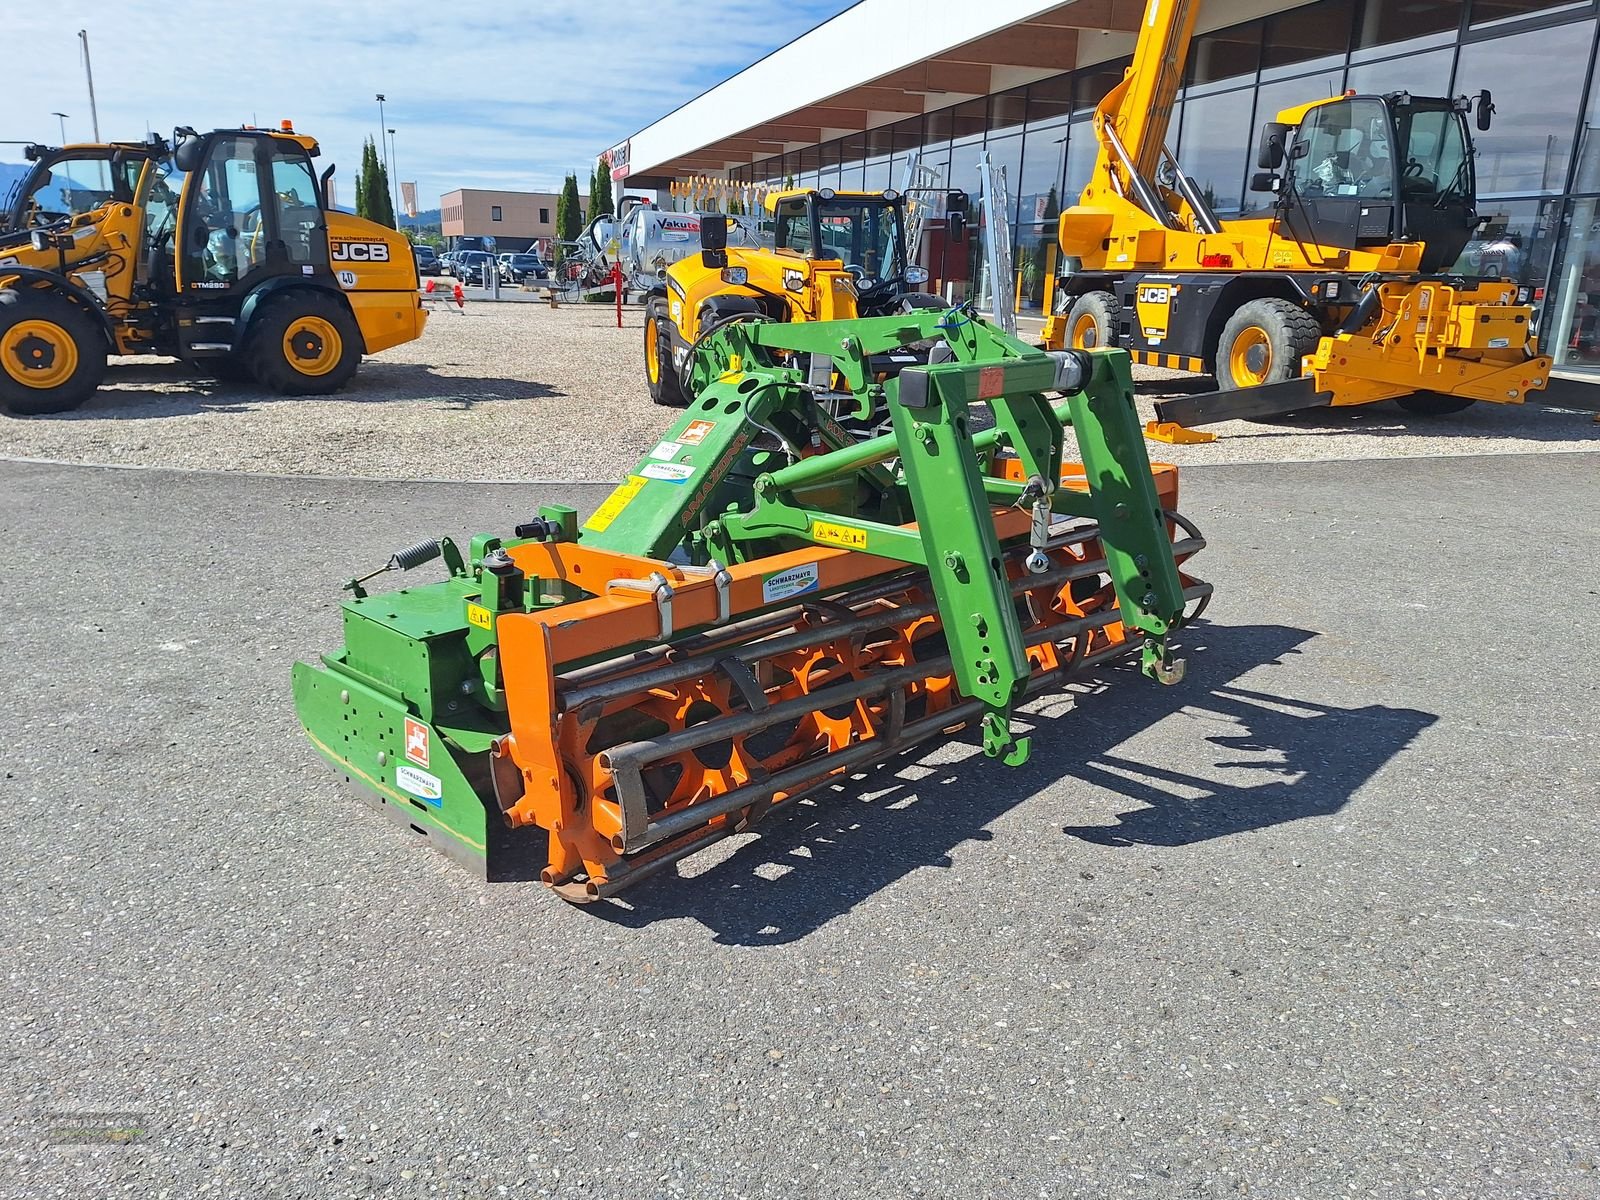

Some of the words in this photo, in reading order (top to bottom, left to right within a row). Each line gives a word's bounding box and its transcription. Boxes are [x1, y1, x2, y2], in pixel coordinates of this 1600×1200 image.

[332, 243, 389, 261] JCB
[342, 272, 354, 284] 40
[1140, 288, 1168, 303] JCB
[682, 432, 749, 528] AMAZONE
[768, 570, 811, 587] SCHWARZMAYR
[400, 767, 436, 788] SCHWARZMAYR
